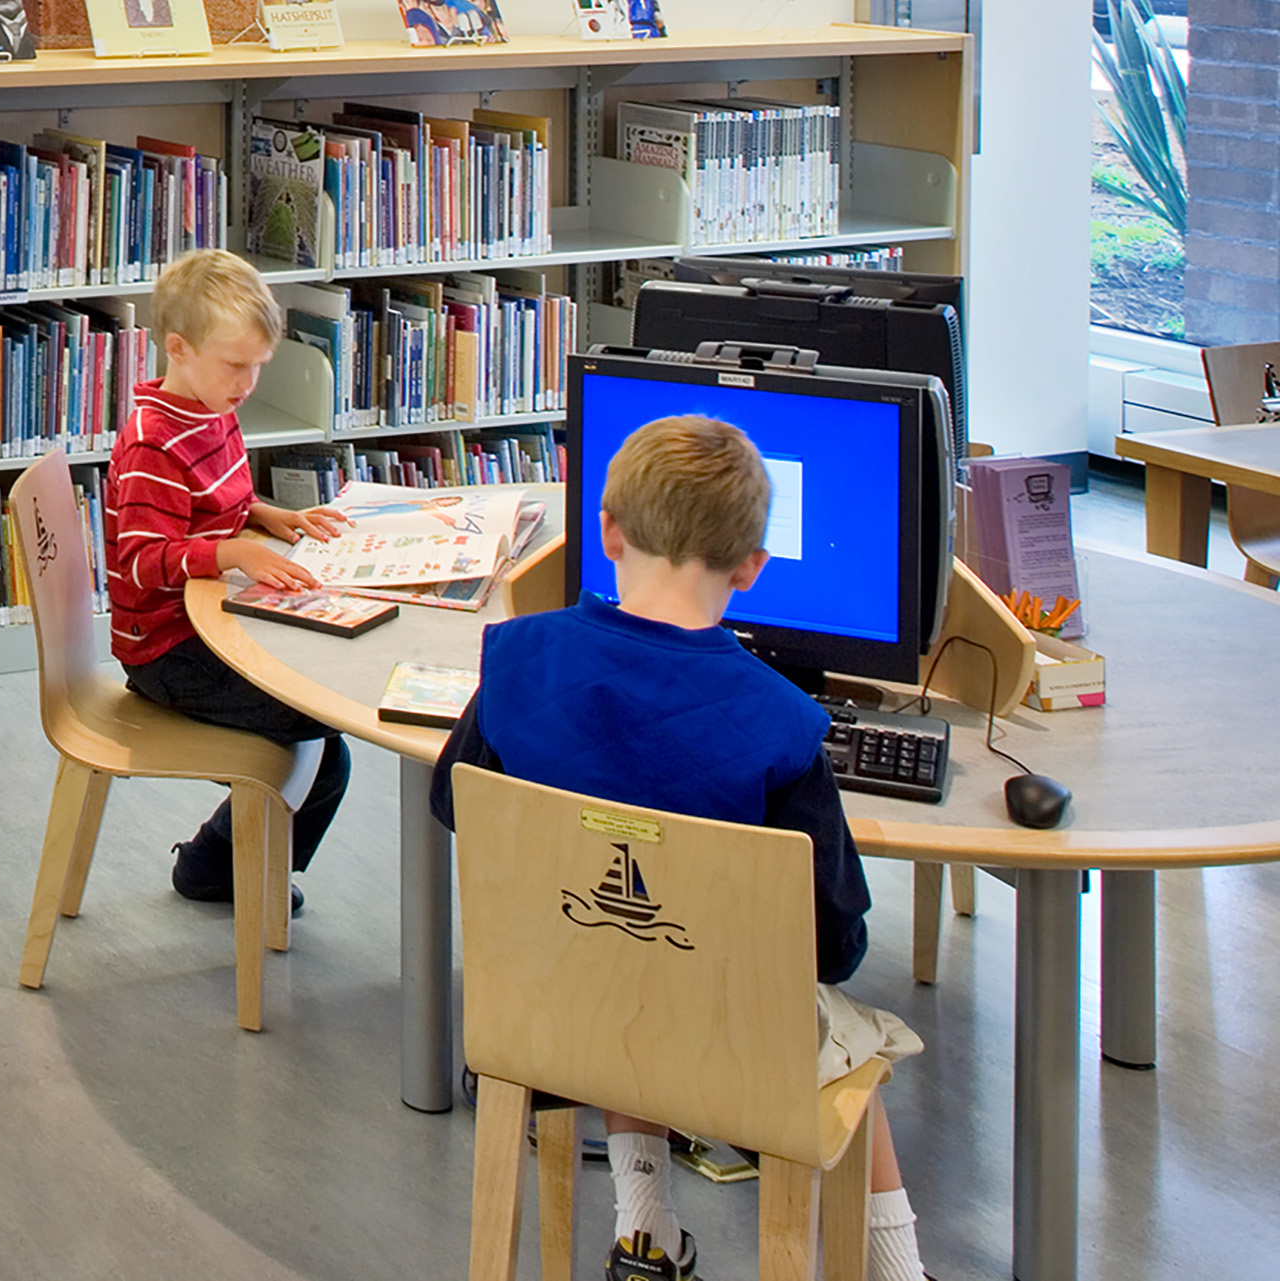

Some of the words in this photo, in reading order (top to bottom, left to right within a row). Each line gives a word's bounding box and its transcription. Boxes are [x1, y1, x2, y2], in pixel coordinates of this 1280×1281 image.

[270, 8, 333, 23] HATSHEPSUT
[633, 141, 679, 159] AMAZING
[253, 156, 315, 183] WEATHER
